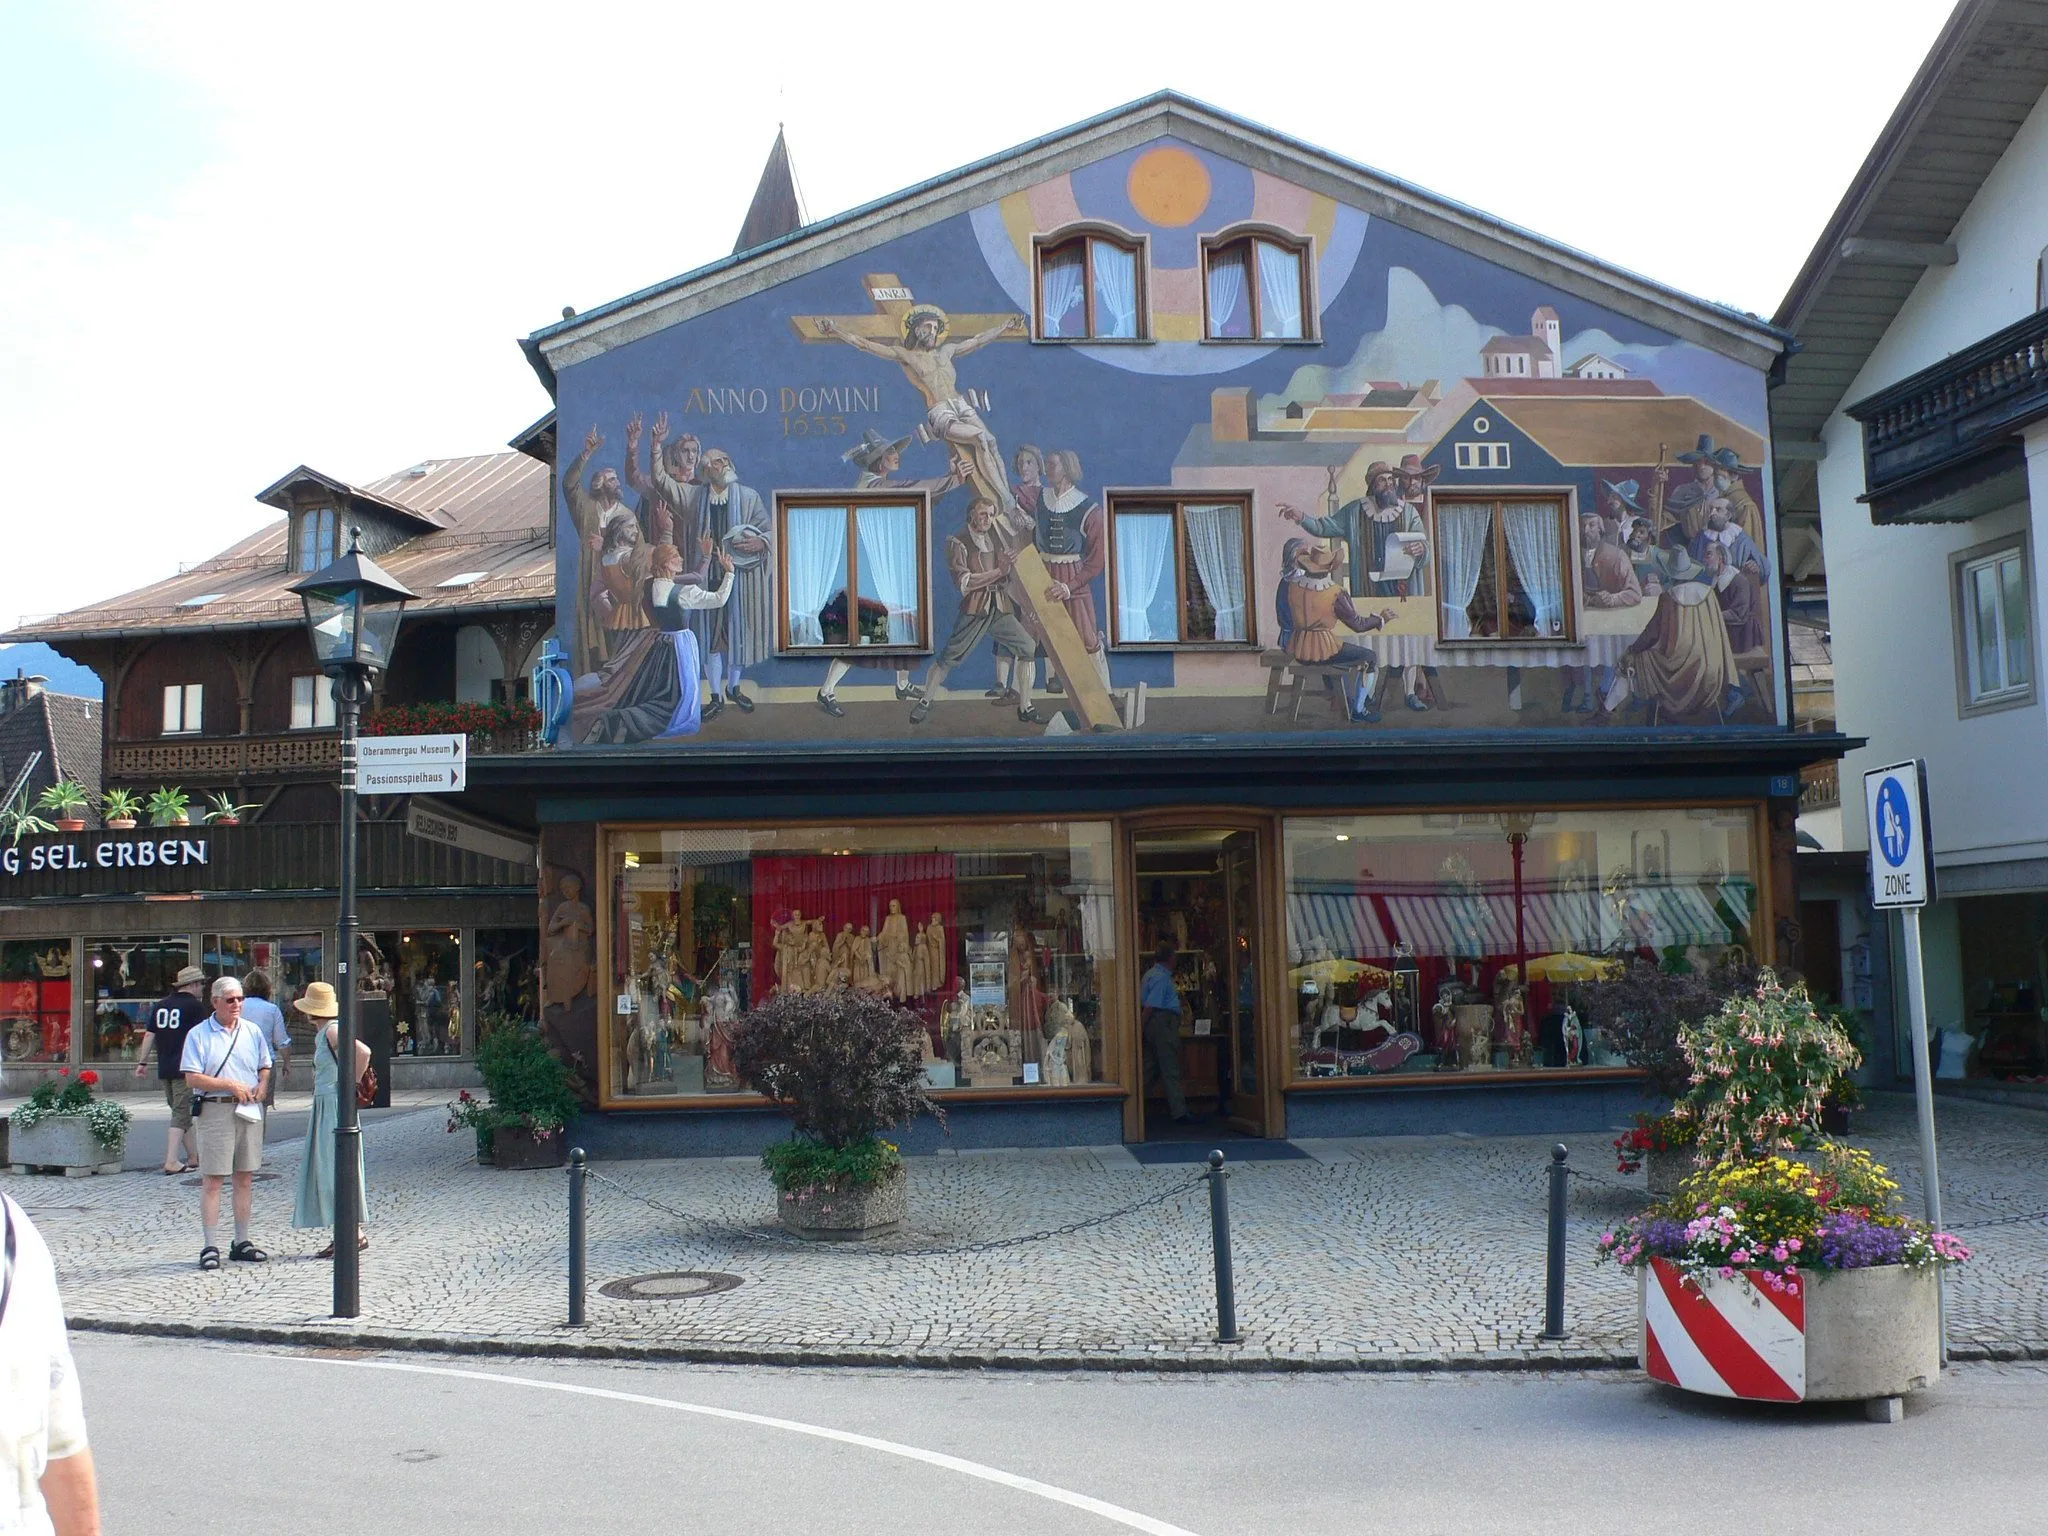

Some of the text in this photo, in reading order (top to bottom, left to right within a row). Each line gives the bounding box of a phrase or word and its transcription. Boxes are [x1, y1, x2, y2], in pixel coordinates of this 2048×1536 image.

[684, 386, 880, 414] ANNO DOMINI
[362, 744, 451, 757] Oberammergau Museum
[366, 772, 444, 786] Passionsspielhaus
[31, 844, 88, 871] SEL.
[1884, 873, 1912, 896] ZONE
[156, 1008, 181, 1029] 08
